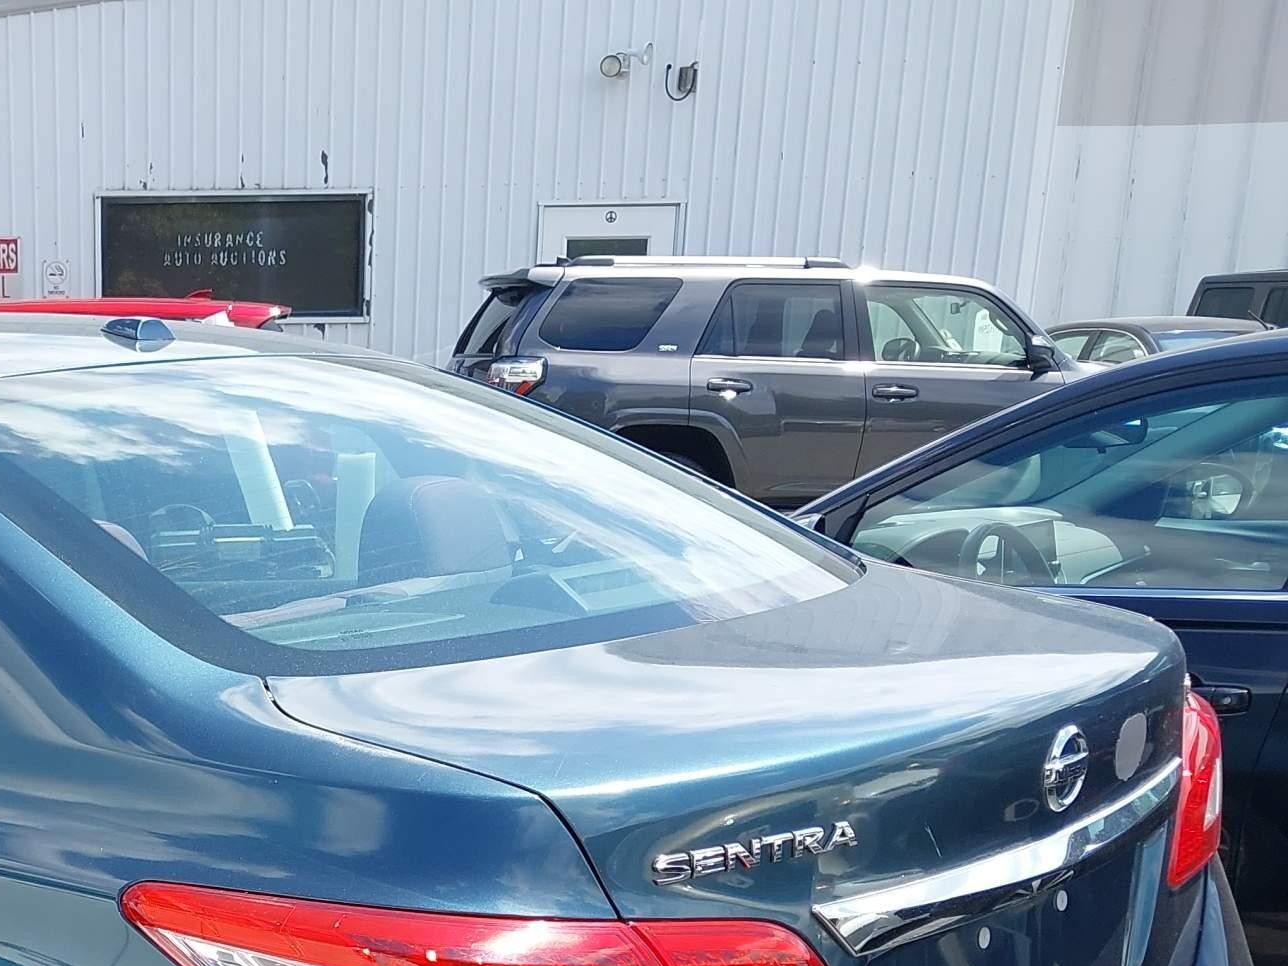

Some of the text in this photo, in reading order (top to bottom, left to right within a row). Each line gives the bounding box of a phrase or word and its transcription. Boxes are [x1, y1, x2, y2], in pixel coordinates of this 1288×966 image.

[177, 231, 263, 248] INSURANCE
[164, 249, 287, 266] AUTO AUCTIONS
[652, 820, 859, 886] SENTRA
